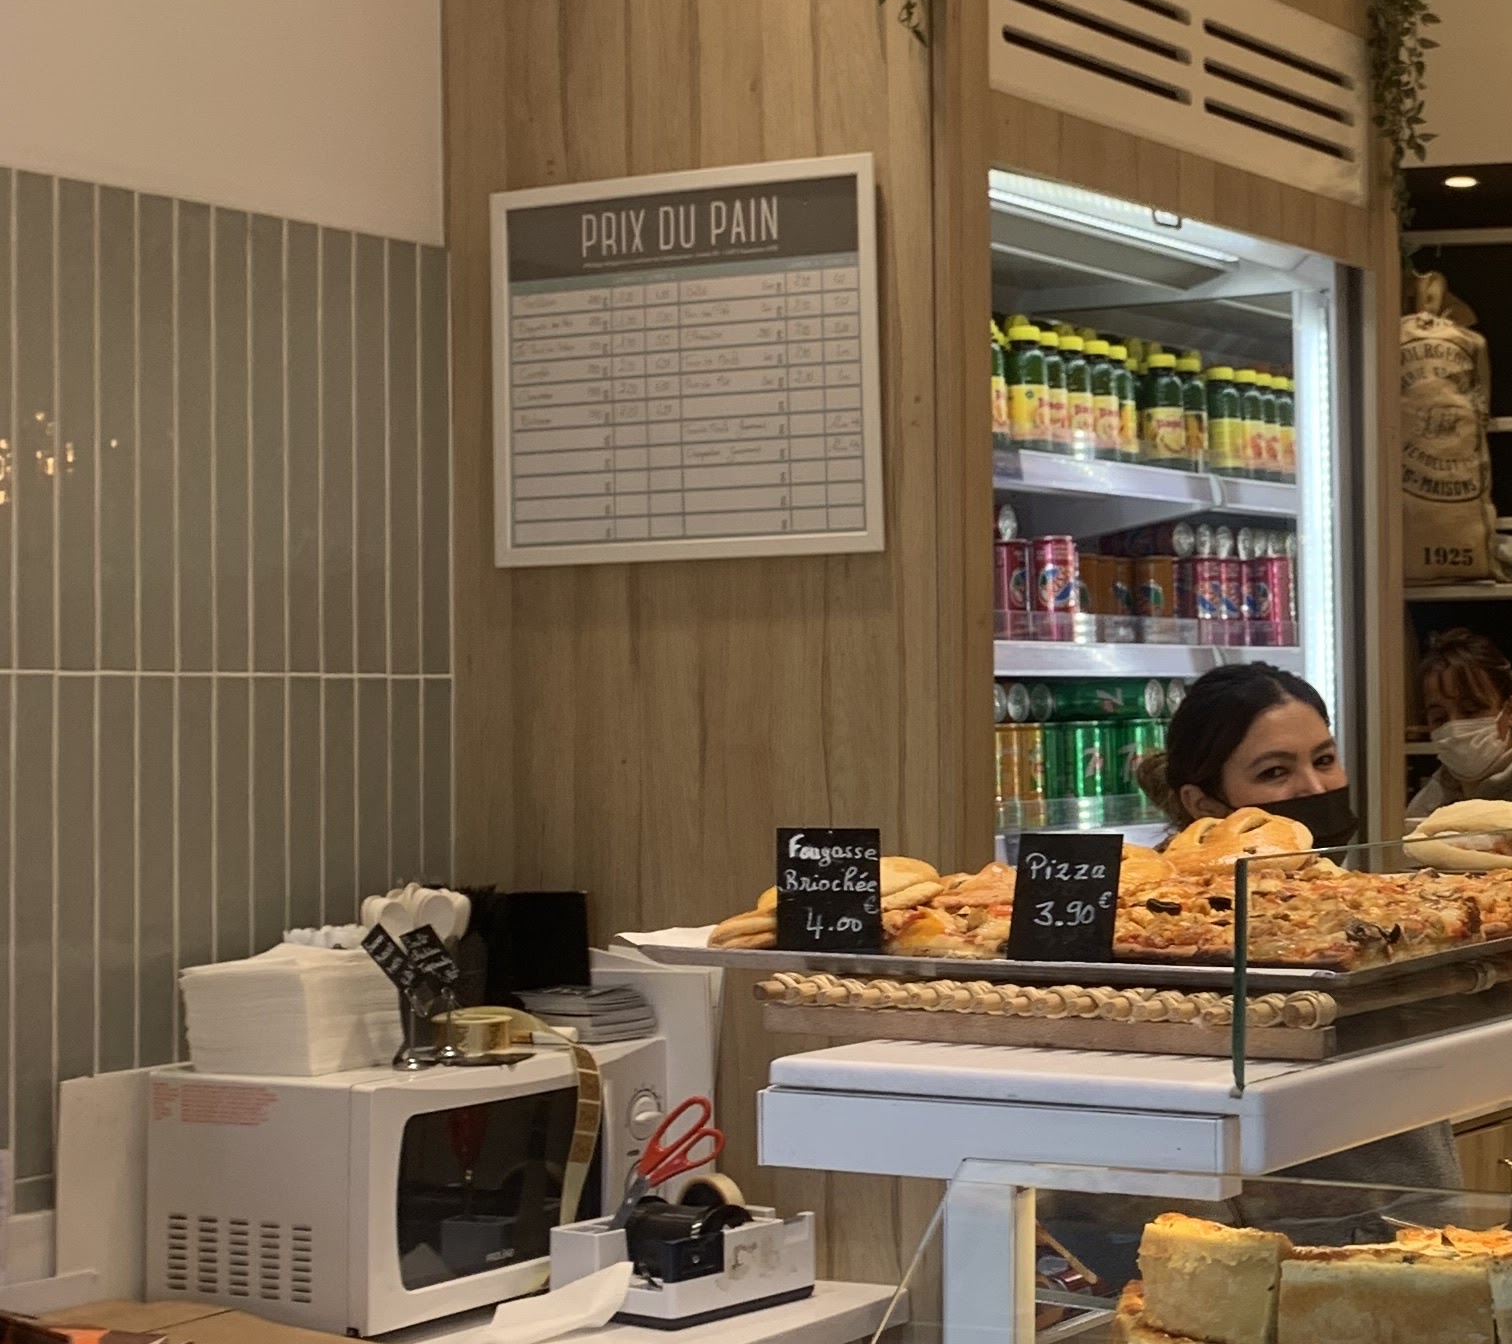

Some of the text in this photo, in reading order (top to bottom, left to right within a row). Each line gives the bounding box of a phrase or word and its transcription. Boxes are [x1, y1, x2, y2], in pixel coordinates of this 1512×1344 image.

[581, 196, 779, 258] PRIX DU PAIN
[1423, 546, 1474, 567] 1925
[781, 866, 878, 895] Briochée
[1025, 852, 1106, 882] Pizza
